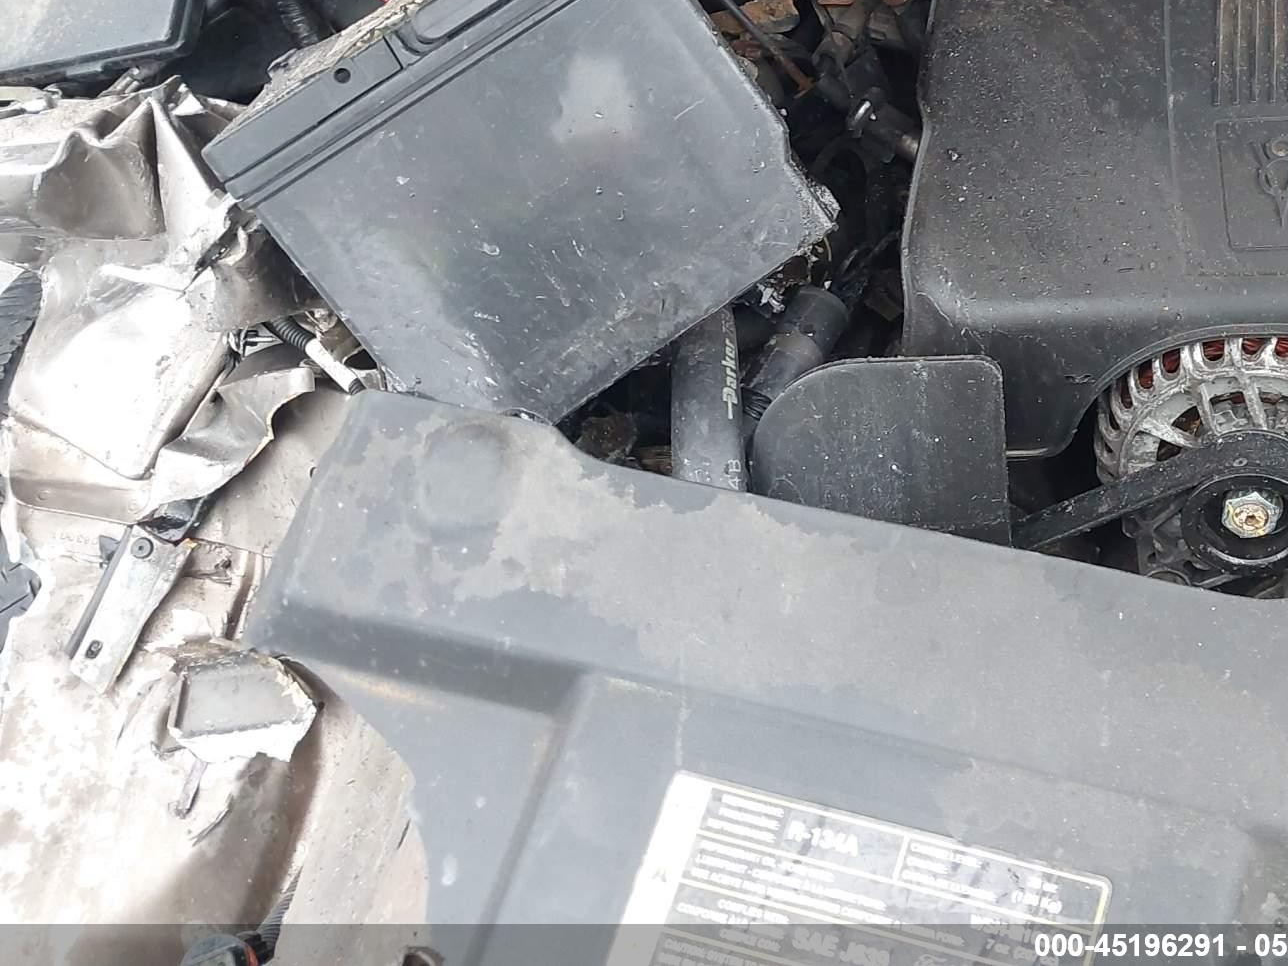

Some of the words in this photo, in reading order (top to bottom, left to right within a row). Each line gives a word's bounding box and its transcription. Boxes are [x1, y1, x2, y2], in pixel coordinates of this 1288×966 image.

[720, 338, 738, 419] Parker
[786, 820, 859, 857] R-134A
[792, 926, 836, 957] SAE
